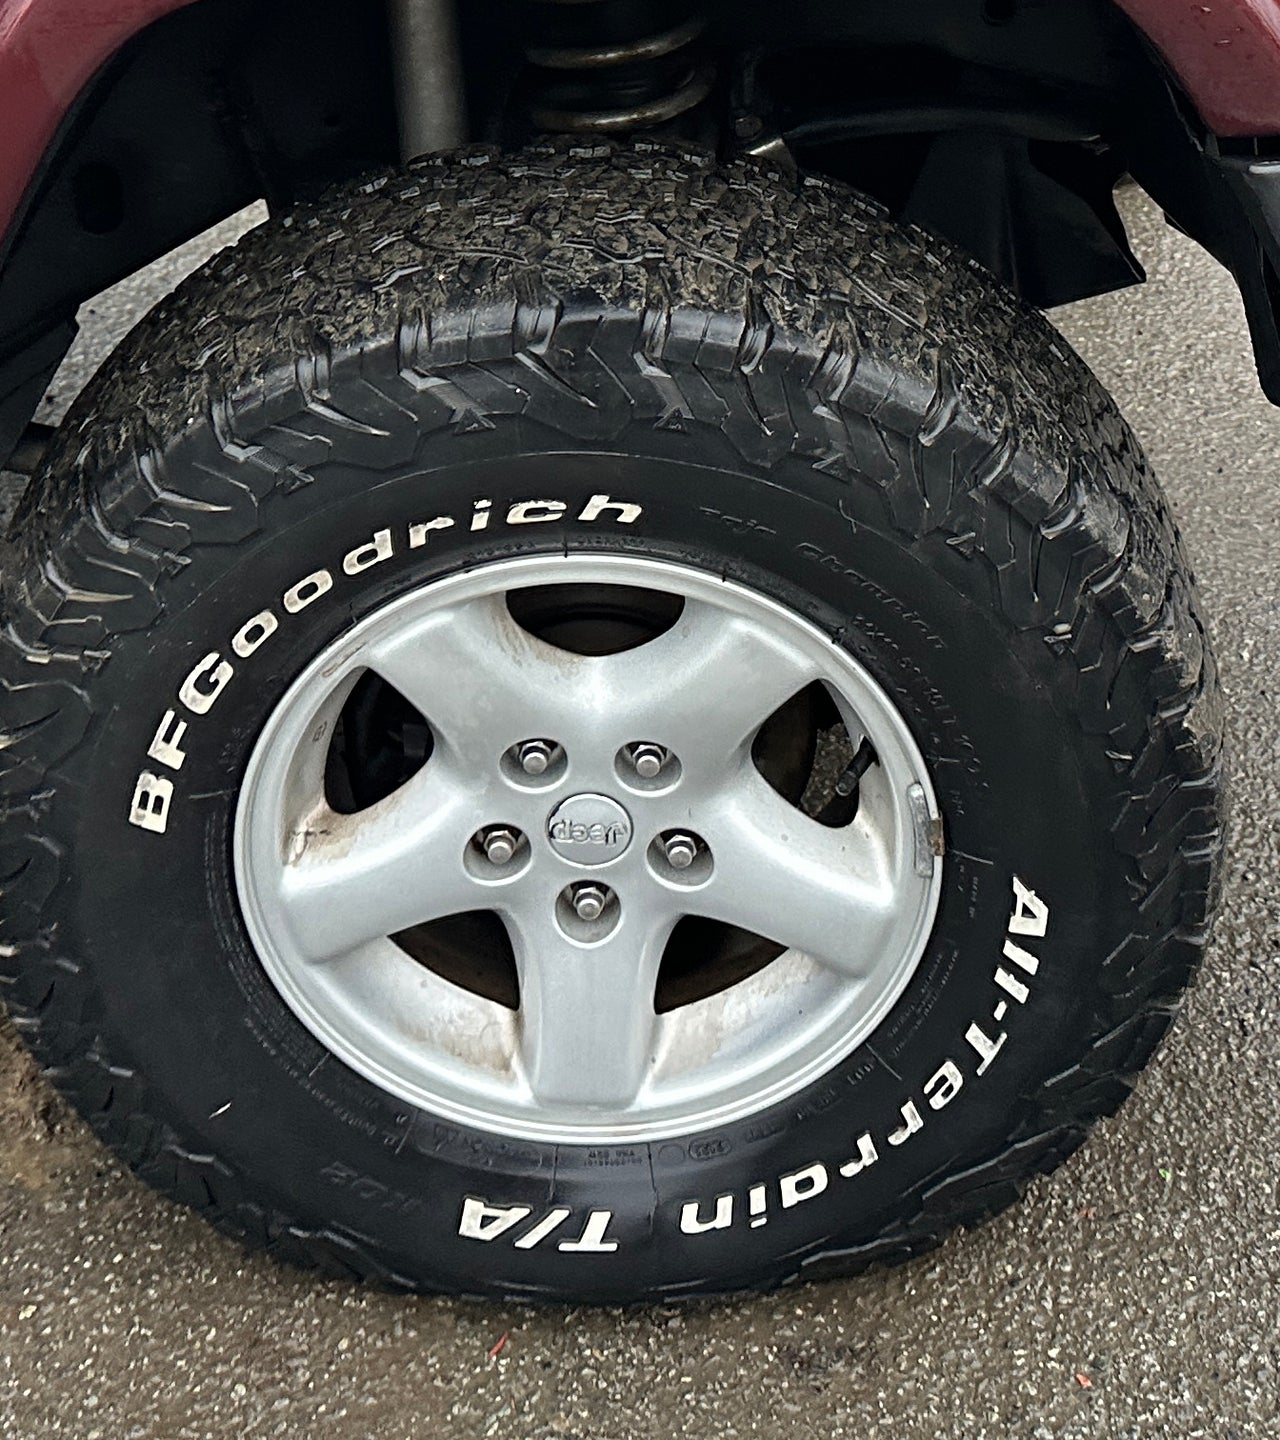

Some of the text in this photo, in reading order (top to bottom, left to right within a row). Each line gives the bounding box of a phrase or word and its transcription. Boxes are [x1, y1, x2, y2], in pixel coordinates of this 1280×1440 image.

[128, 493, 644, 834] BFGoodrich
[549, 819, 627, 848] Jeep
[678, 874, 1050, 1236] All-Terrain
[458, 1197, 619, 1253] T/A
